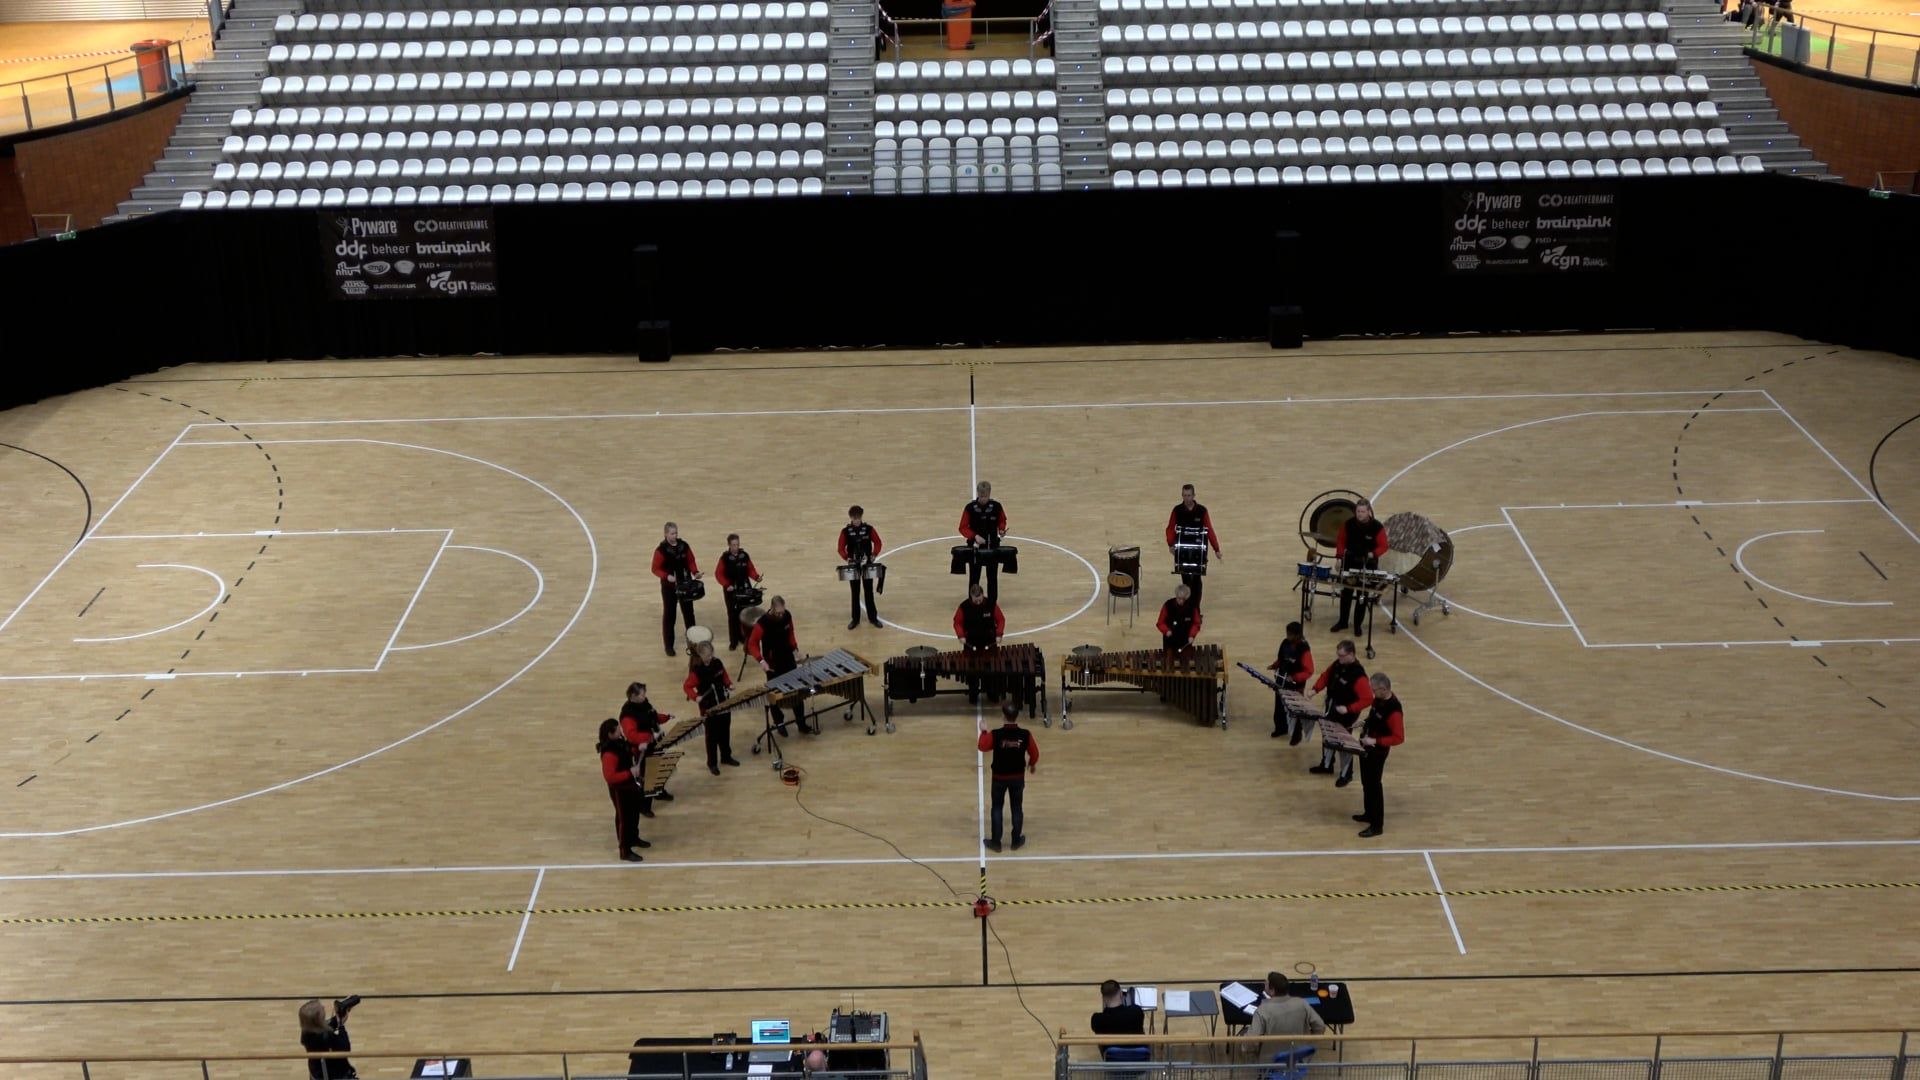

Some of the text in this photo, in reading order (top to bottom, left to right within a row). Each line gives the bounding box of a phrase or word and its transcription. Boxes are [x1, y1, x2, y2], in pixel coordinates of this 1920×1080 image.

[1476, 192, 1522, 212] Pyware
[352, 217, 398, 237] Pyware
[1455, 214, 1530, 234] ddf beheer
[1536, 215, 1612, 230] brainpink
[336, 239, 410, 260] ddf beheer
[416, 240, 492, 255] brainpink
[1552, 255, 1580, 270] cgn
[439, 280, 467, 294] cgn
